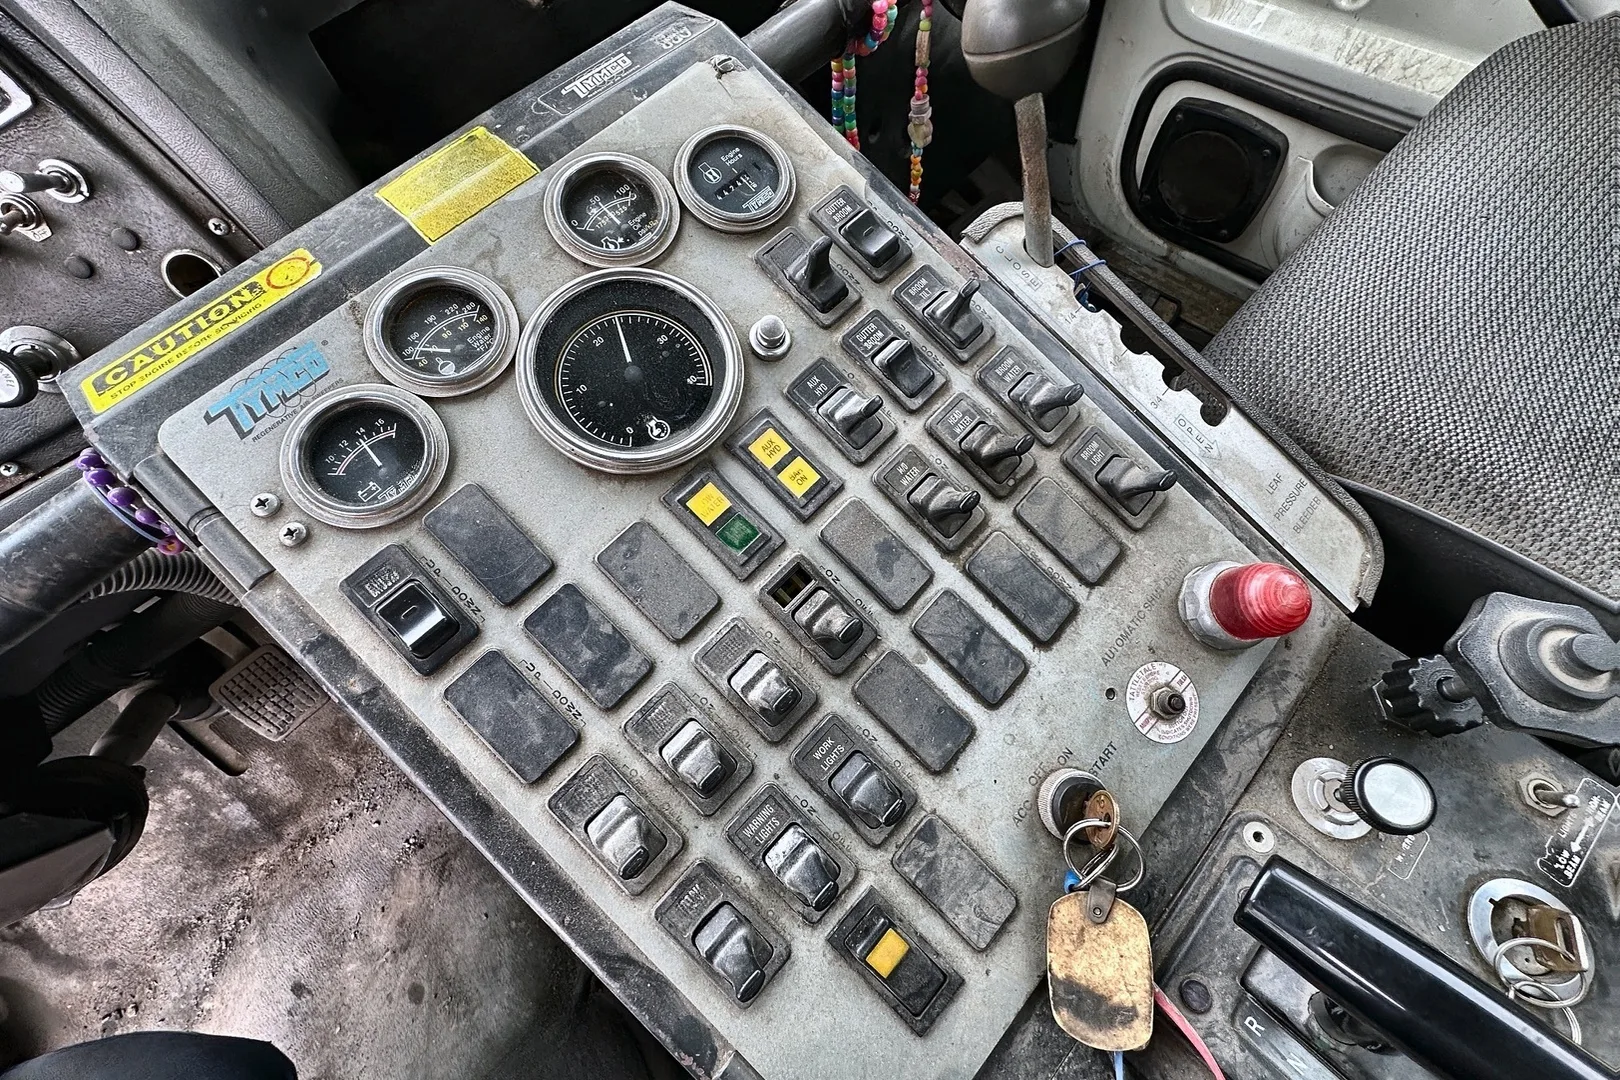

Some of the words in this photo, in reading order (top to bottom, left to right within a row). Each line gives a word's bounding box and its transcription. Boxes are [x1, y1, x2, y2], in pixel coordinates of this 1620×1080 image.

[560, 51, 633, 98] TYMCO
[720, 147, 740, 162] Engine
[725, 153, 743, 166] Hours
[616, 184, 630, 196] 100
[589, 195, 601, 205] 50
[825, 197, 846, 215] GUTTER
[628, 212, 647, 226] Engine
[833, 205, 853, 222] BROOM
[632, 222, 641, 231] Oil
[996, 245, 1040, 288] CLOSE
[909, 277, 929, 296] BROOM
[919, 287, 933, 300] TILT
[445, 303, 459, 315] 220
[462, 301, 476, 314] 280
[424, 315, 437, 326] 190
[457, 322, 469, 332] 110
[476, 314, 488, 325] 140
[1065, 312, 1077, 326] 1/4
[105, 289, 254, 385] CAUTION
[407, 331, 420, 343] 160
[441, 330, 452, 339] 90
[466, 326, 490, 344] Engine
[656, 334, 669, 345] 30
[856, 322, 877, 341] GUTTER
[864, 330, 885, 350] BROOM
[472, 333, 492, 349] Water
[592, 336, 605, 347] 20
[402, 346, 415, 357] 100
[418, 359, 428, 367] 40
[994, 357, 1015, 376] BROOM
[110, 381, 137, 399] STOP
[139, 357, 175, 381] ENGINE
[687, 375, 698, 385] 40
[806, 375, 821, 389] AUX
[1003, 365, 1022, 383] WATER
[203, 340, 330, 440] TYMCO
[576, 384, 588, 395] 10
[814, 383, 828, 397] HYD
[1150, 396, 1163, 409] 3/4
[252, 408, 298, 442] REGENERATIVE
[374, 418, 385, 428] 16
[947, 409, 962, 426] HEAD
[953, 415, 973, 435] WATER
[355, 427, 366, 437] 14
[625, 426, 634, 435] 0
[1178, 417, 1214, 453] OPEN
[338, 439, 349, 449] 12
[760, 438, 775, 453] AUX
[766, 444, 782, 459] HYD
[1080, 440, 1100, 461] BROOM
[325, 455, 335, 464] 10
[1090, 450, 1105, 466] LIGHT
[796, 475, 808, 486] ON
[900, 466, 920, 486] WATER
[1265, 472, 1283, 496] LEAF
[700, 497, 725, 518] WATER
[1273, 477, 1308, 522] PRESSURE
[1292, 496, 1322, 534] BLEEDER
[825, 569, 840, 585] ON
[425, 560, 441, 577] UP
[451, 586, 481, 615] DOWN
[1101, 610, 1146, 666] AUTOMATIC
[1143, 588, 1164, 612] SHUT
[764, 630, 780, 645] ON
[1128, 663, 1157, 701] TATTLETALE
[525, 662, 541, 680] UP
[552, 689, 582, 720] DOWN
[700, 697, 716, 710] ON
[862, 728, 878, 742] ON
[812, 737, 835, 760] WORK
[1057, 747, 1074, 766] ON
[820, 744, 845, 771] LIGHTS
[1089, 741, 1117, 777] START
[800, 799, 817, 816] ON
[1012, 800, 1033, 828] ACC
[1594, 799, 1611, 822] BEAM
[742, 804, 775, 838] WARNING
[1558, 812, 1578, 838] LIGHTS
[755, 816, 780, 844] LIGHTS
[1554, 849, 1570, 869] LOW
[1564, 855, 1581, 880] BEAM
[1244, 1017, 1265, 1037] R
[1287, 1053, 1308, 1076] N
